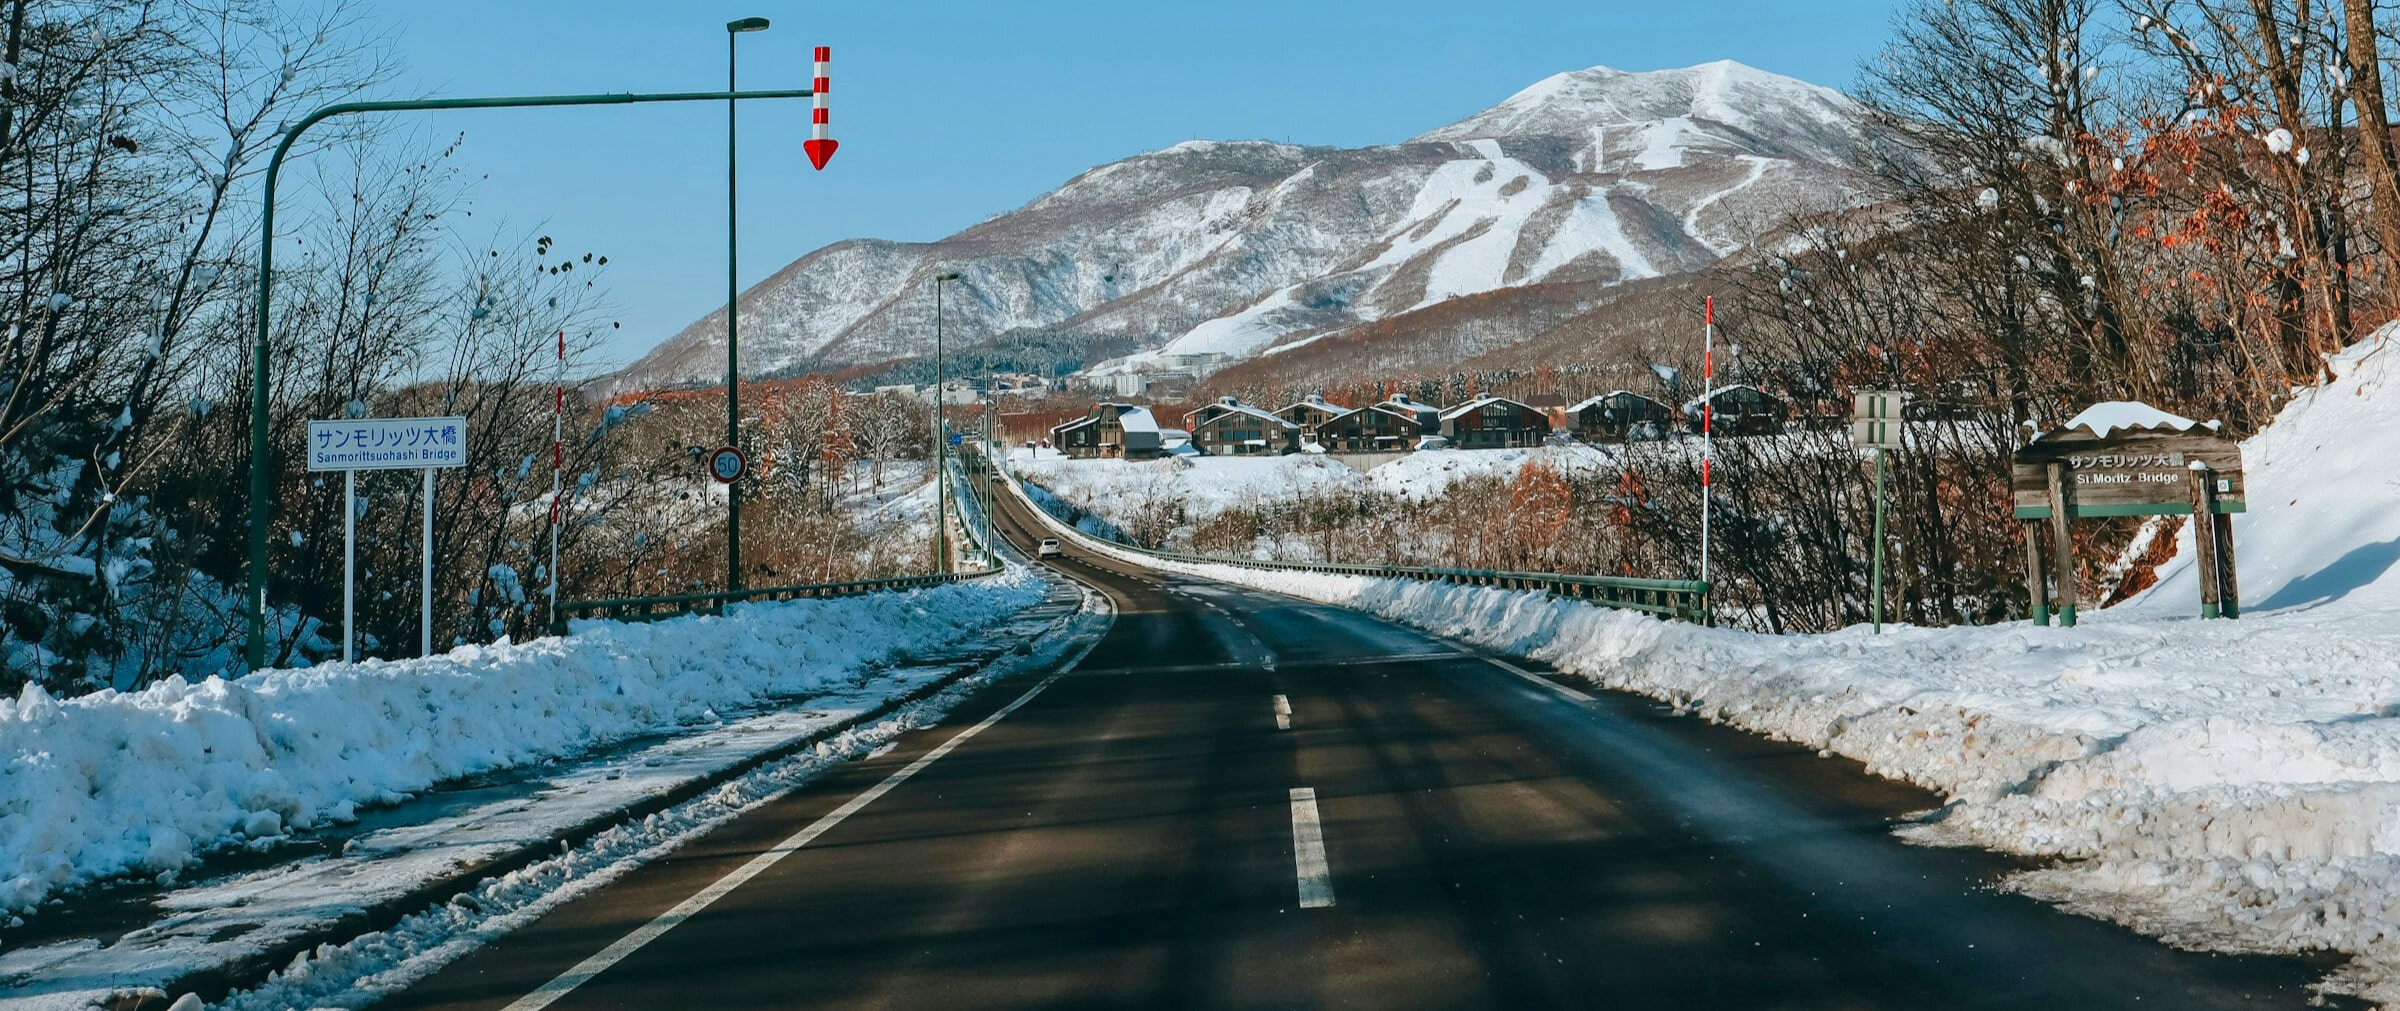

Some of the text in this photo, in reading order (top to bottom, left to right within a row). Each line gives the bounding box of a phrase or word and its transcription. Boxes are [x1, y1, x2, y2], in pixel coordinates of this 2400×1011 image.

[317, 425, 457, 449] サンモリッツ大橋
[317, 448, 457, 463] Sanmorittsuohashi Bridge
[2069, 452, 2185, 469] サンモリッツ大橋
[717, 456, 738, 473] 50
[2138, 472, 2179, 485] Bridge
